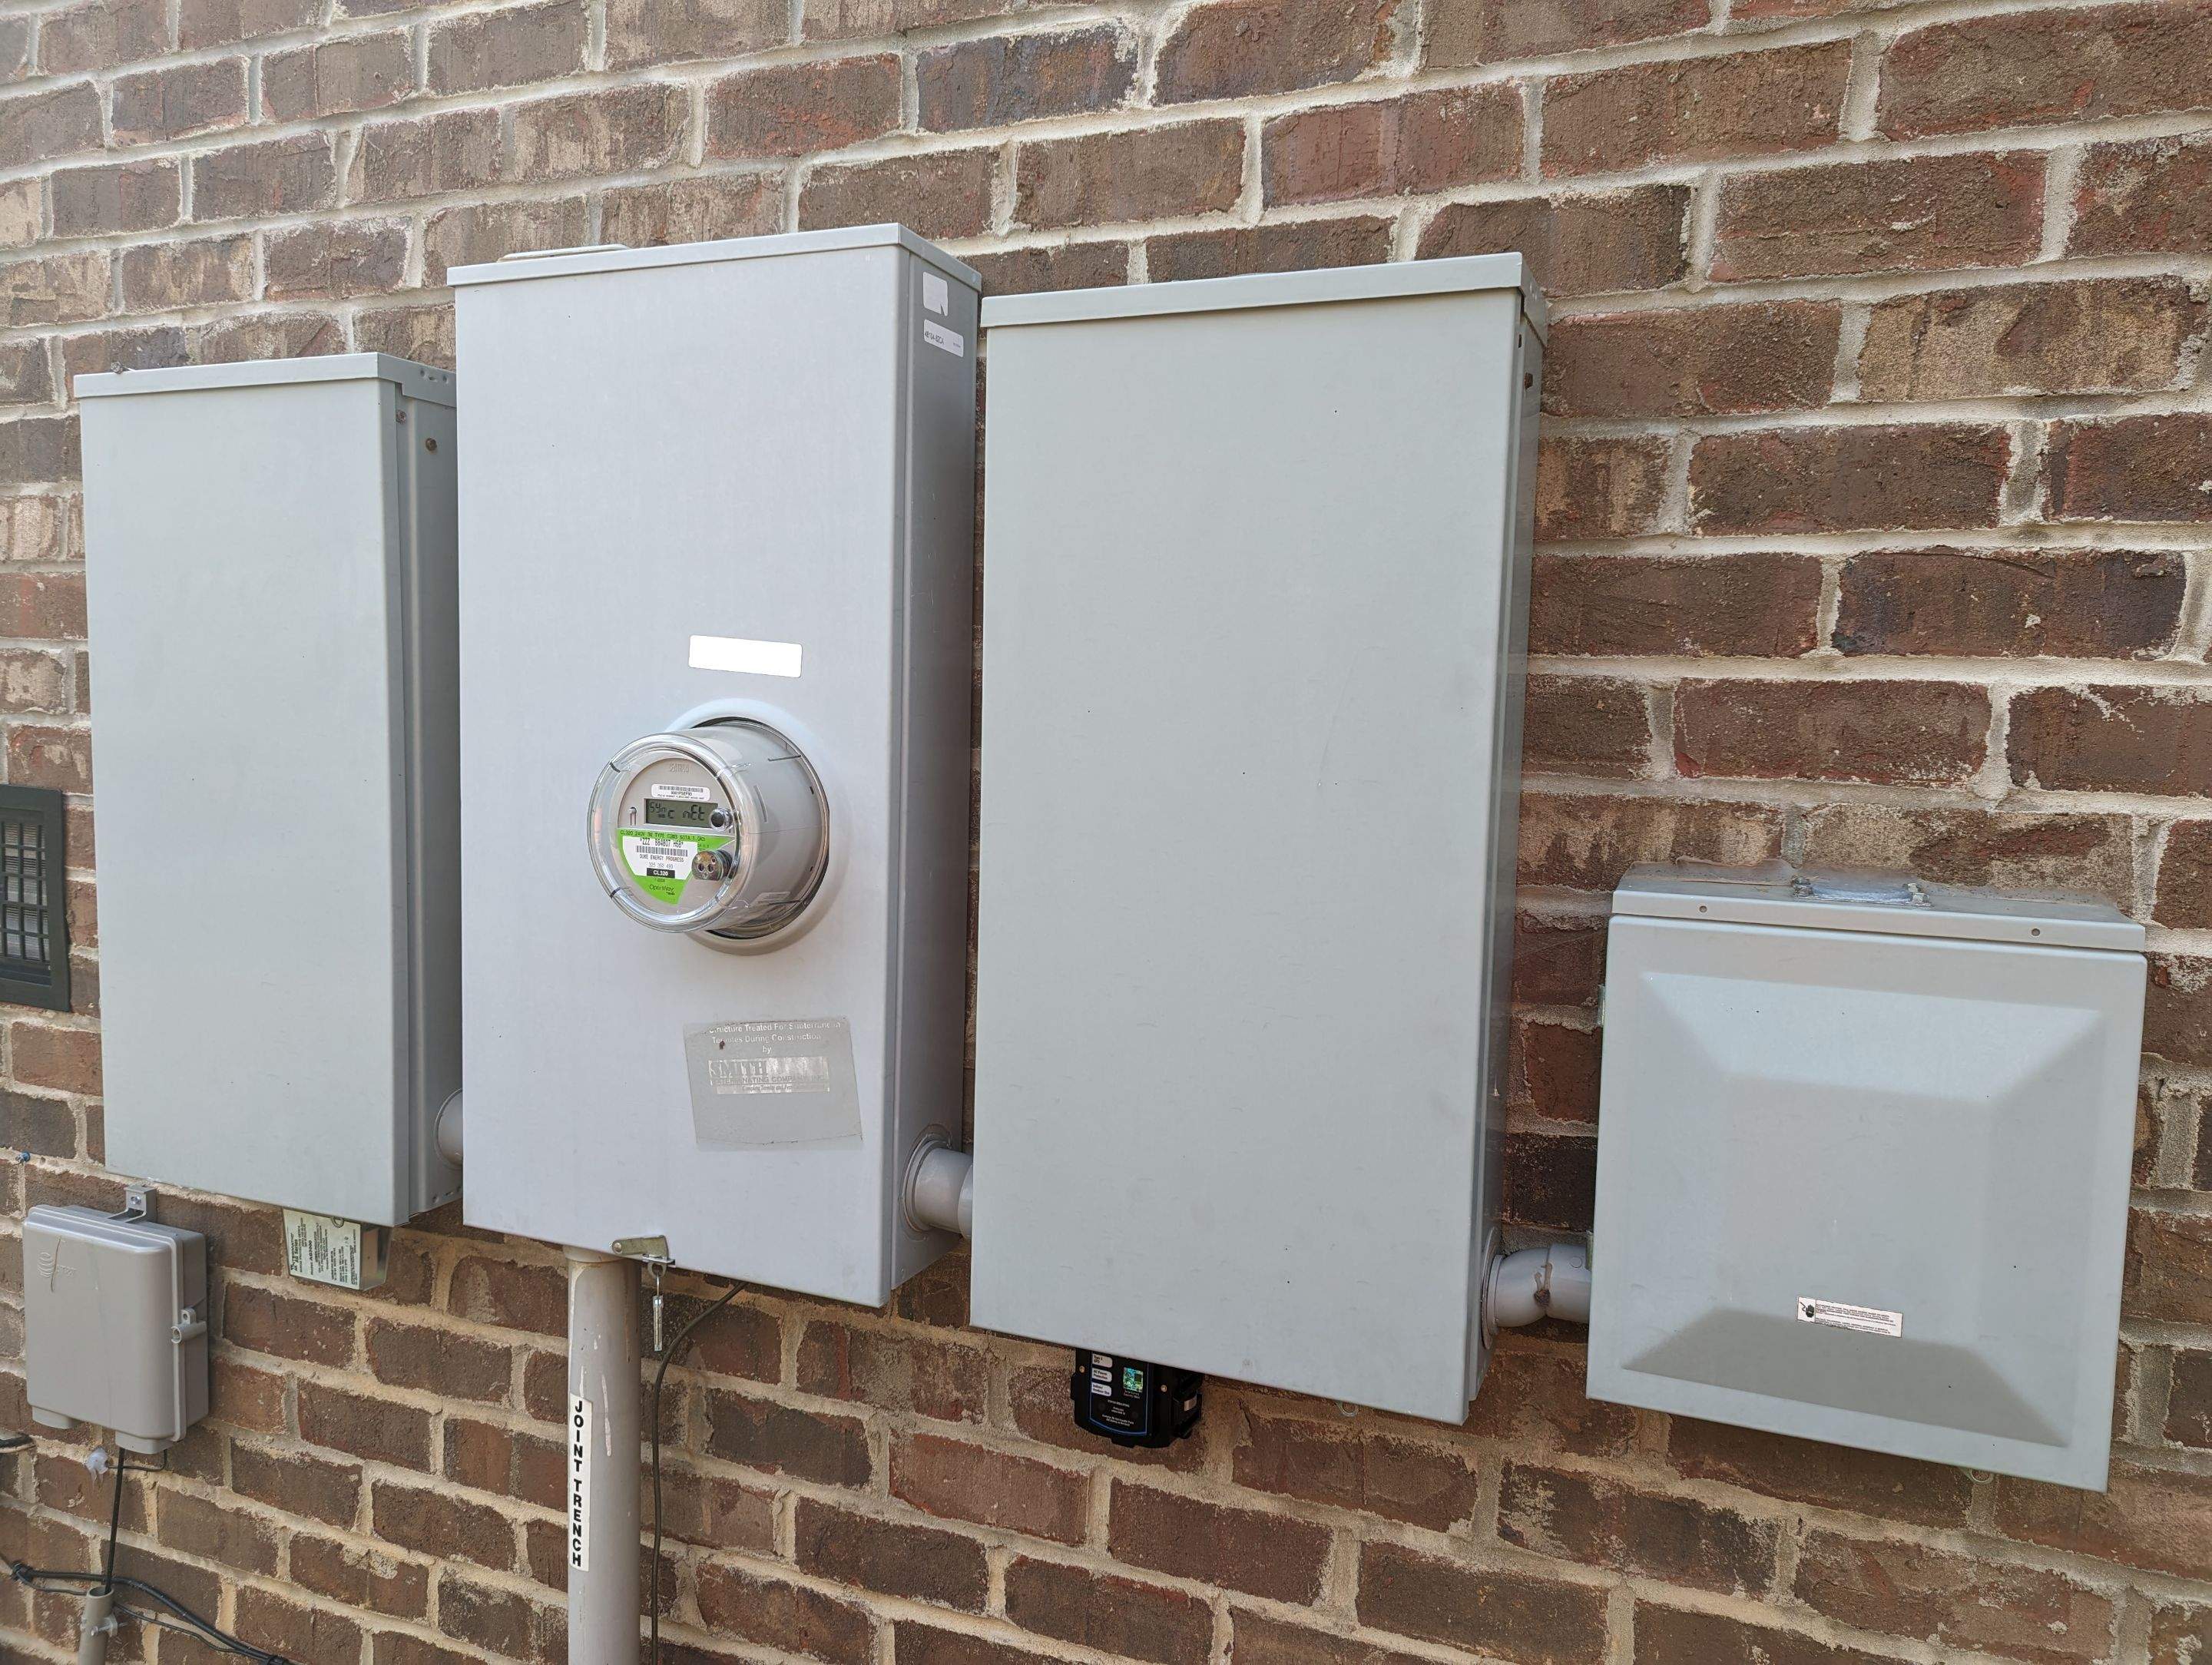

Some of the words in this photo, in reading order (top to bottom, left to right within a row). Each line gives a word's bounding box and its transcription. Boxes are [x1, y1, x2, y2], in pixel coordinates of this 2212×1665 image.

[744, 1023, 773, 1032] Treated
[745, 1034, 770, 1044] During
[763, 1045, 773, 1054] by
[574, 1399, 584, 1472] JOINT
[572, 1478, 582, 1567] TRENCH
